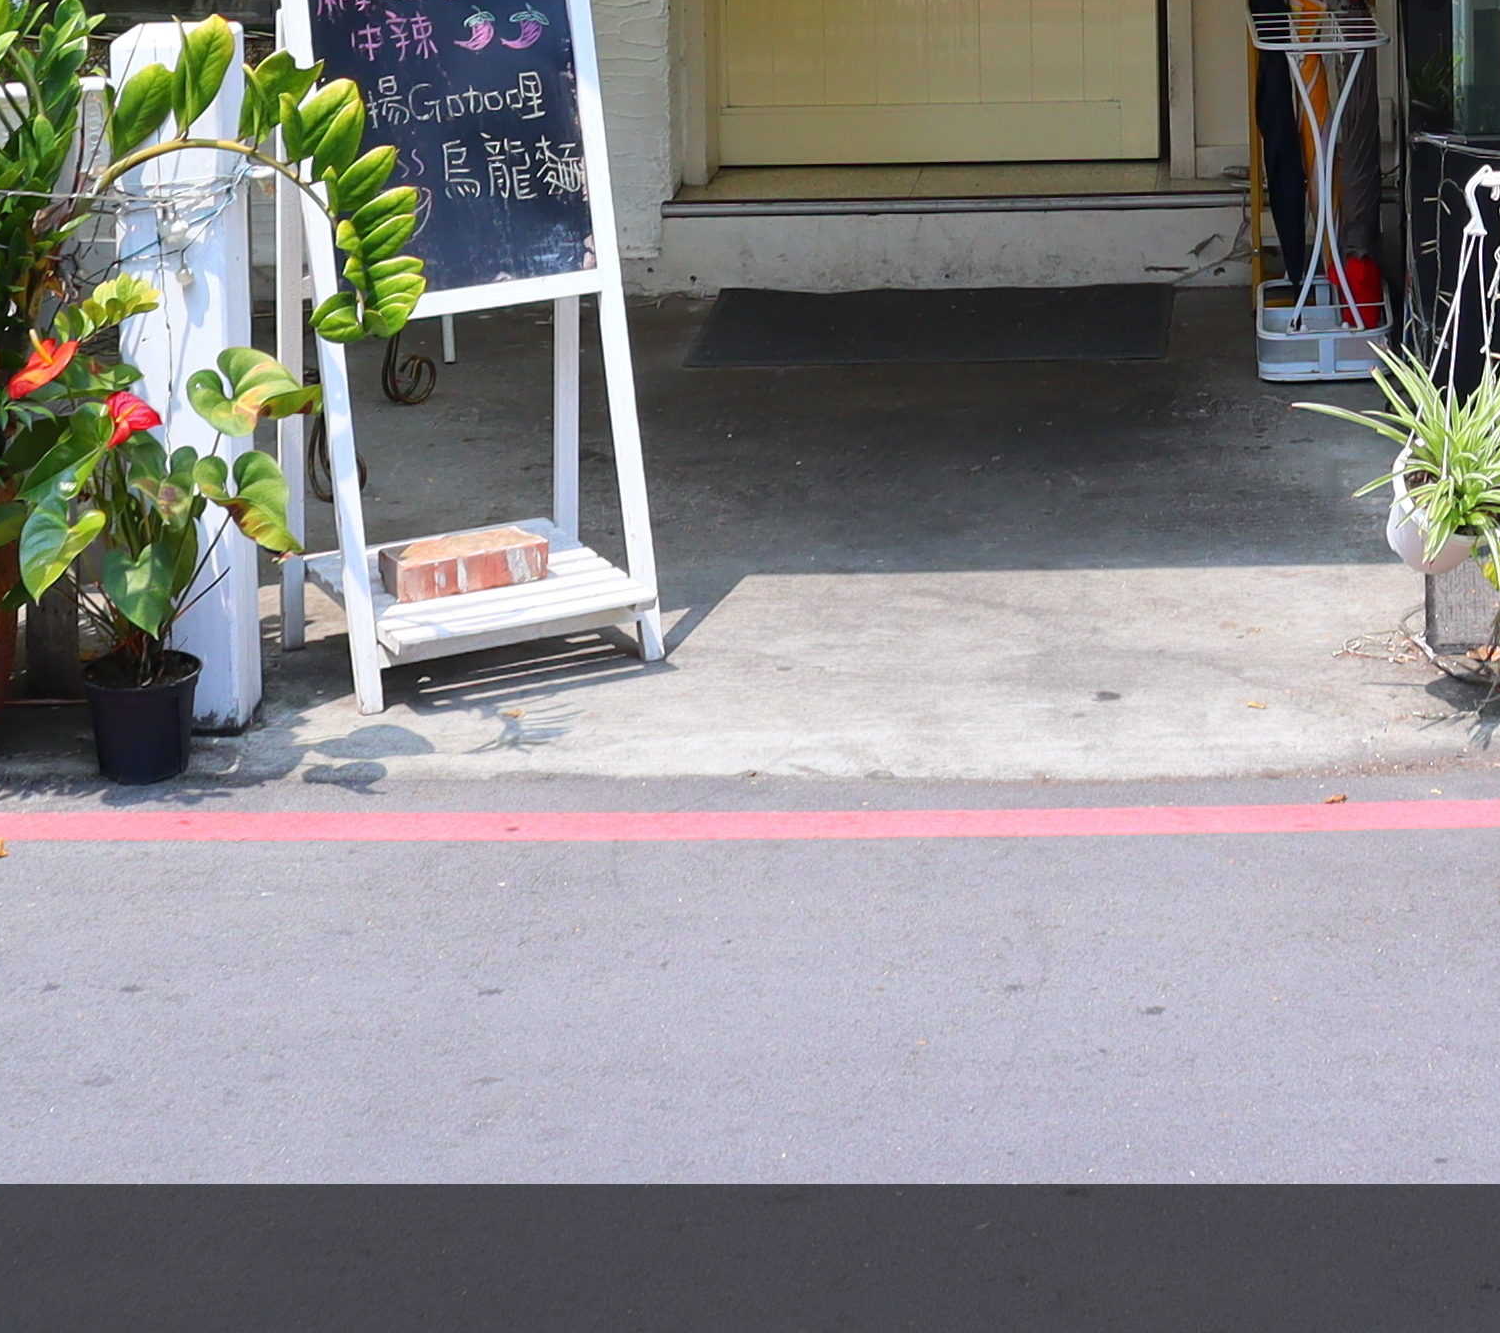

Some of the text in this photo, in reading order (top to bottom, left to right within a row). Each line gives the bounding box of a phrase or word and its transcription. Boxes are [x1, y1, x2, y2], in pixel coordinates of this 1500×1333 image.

[351, 9, 439, 62] 中辣
[441, 131, 585, 201] 烏龍麵
